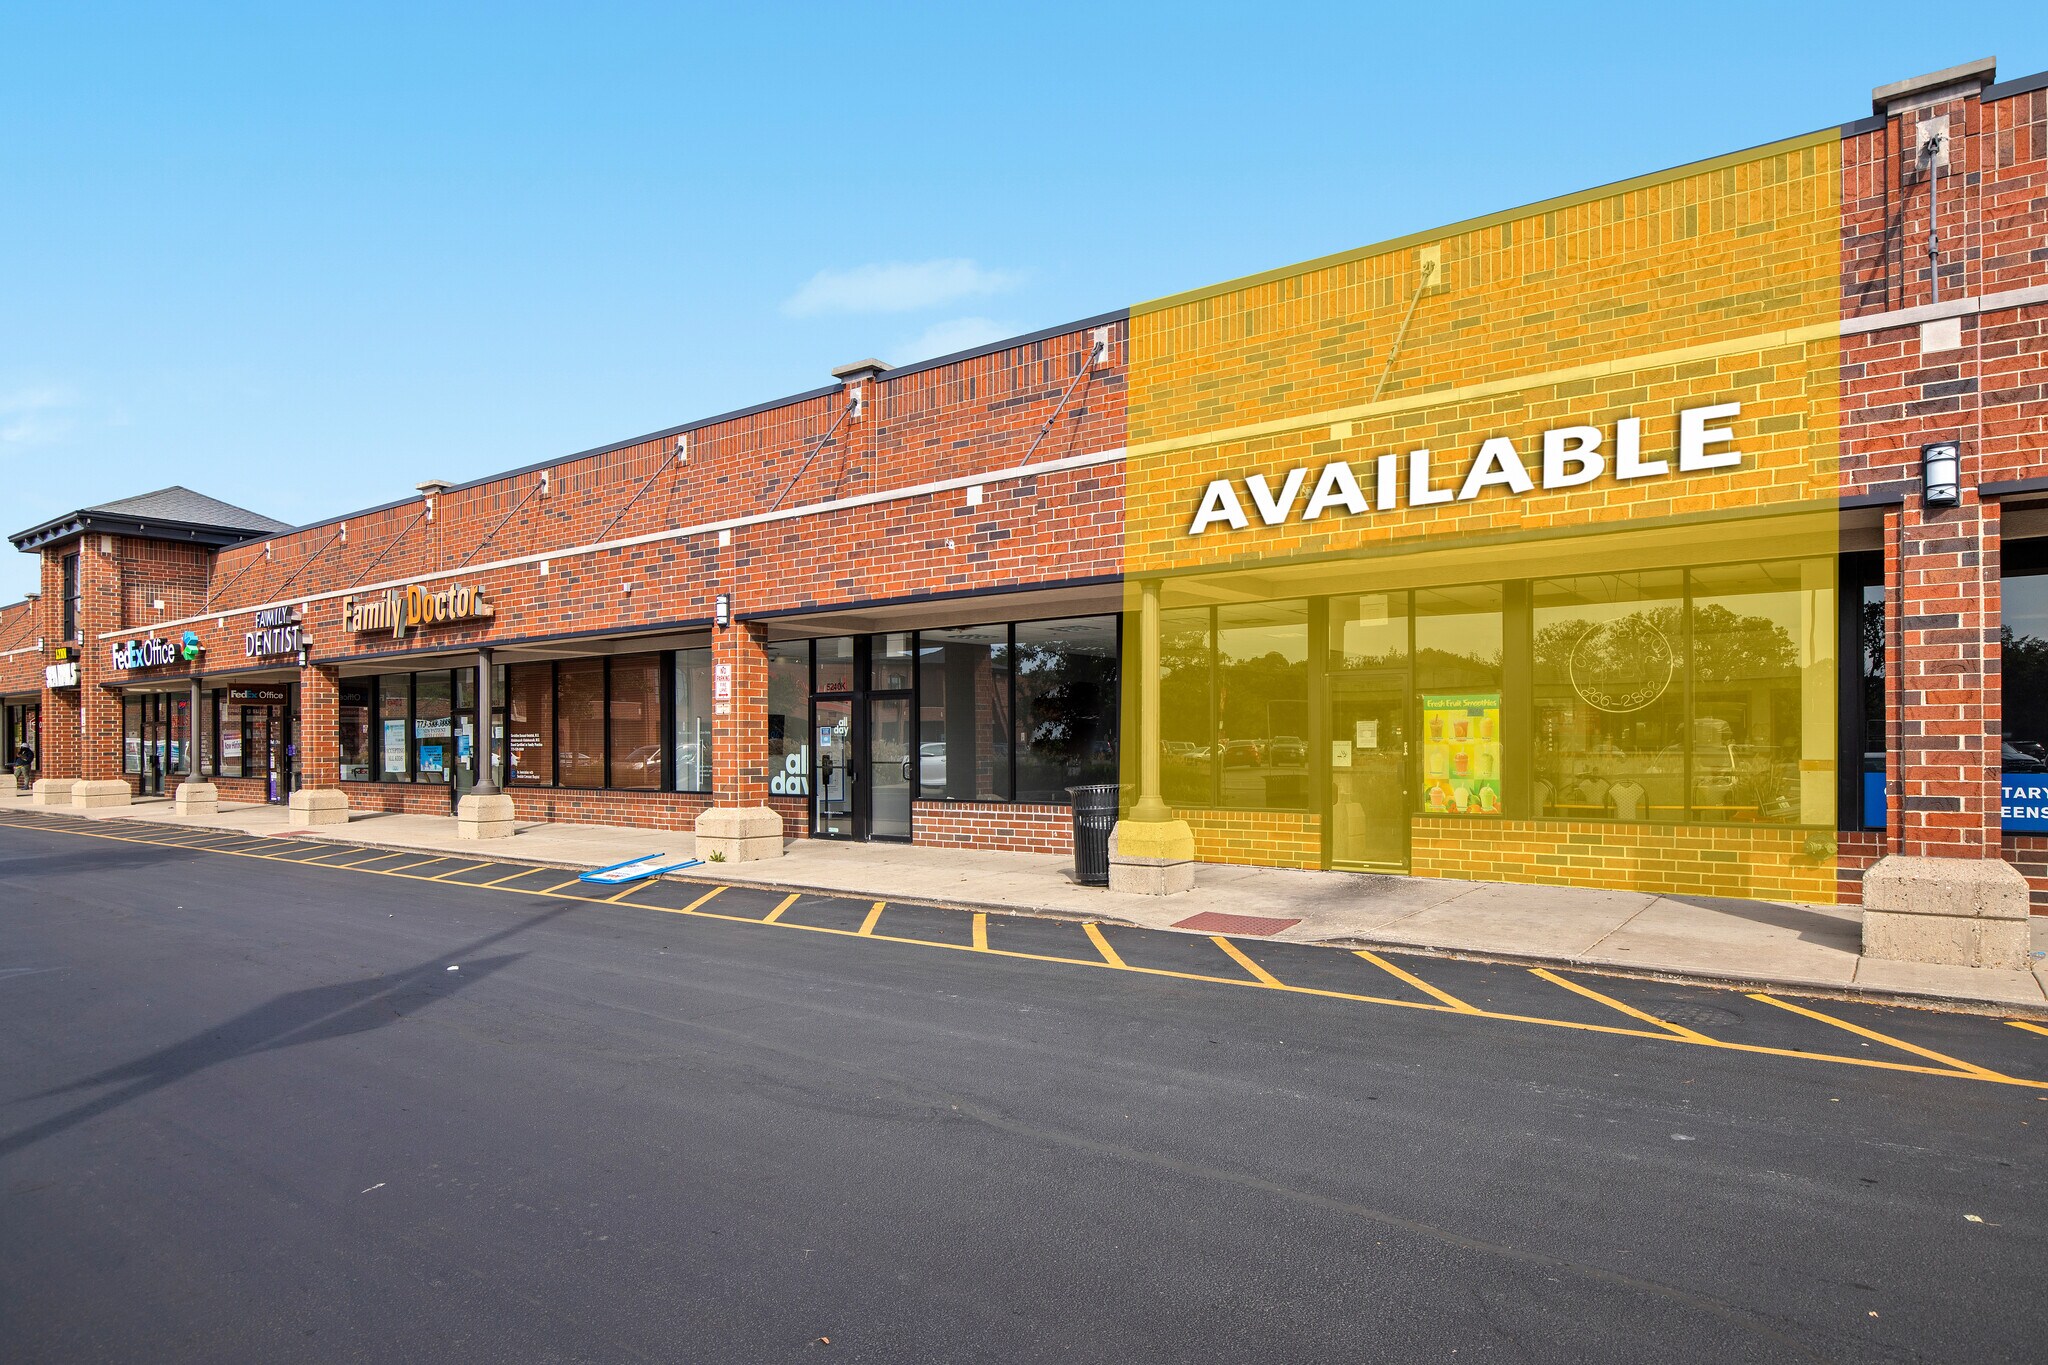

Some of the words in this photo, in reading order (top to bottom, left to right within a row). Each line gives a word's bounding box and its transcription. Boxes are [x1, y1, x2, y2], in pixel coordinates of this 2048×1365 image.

[256, 606, 289, 628] FAMILY
[343, 589, 403, 638] Family
[407, 582, 481, 626] Doctor
[246, 626, 299, 657] DENTIST
[231, 690, 258, 699] FedEx
[259, 690, 284, 700] Office
[1427, 699, 1445, 708] Fresh
[1446, 698, 1461, 708] Fruit
[1463, 698, 1497, 708] Smoothies
[838, 717, 848, 727] all
[833, 725, 849, 737] day
[786, 745, 809, 775] al
